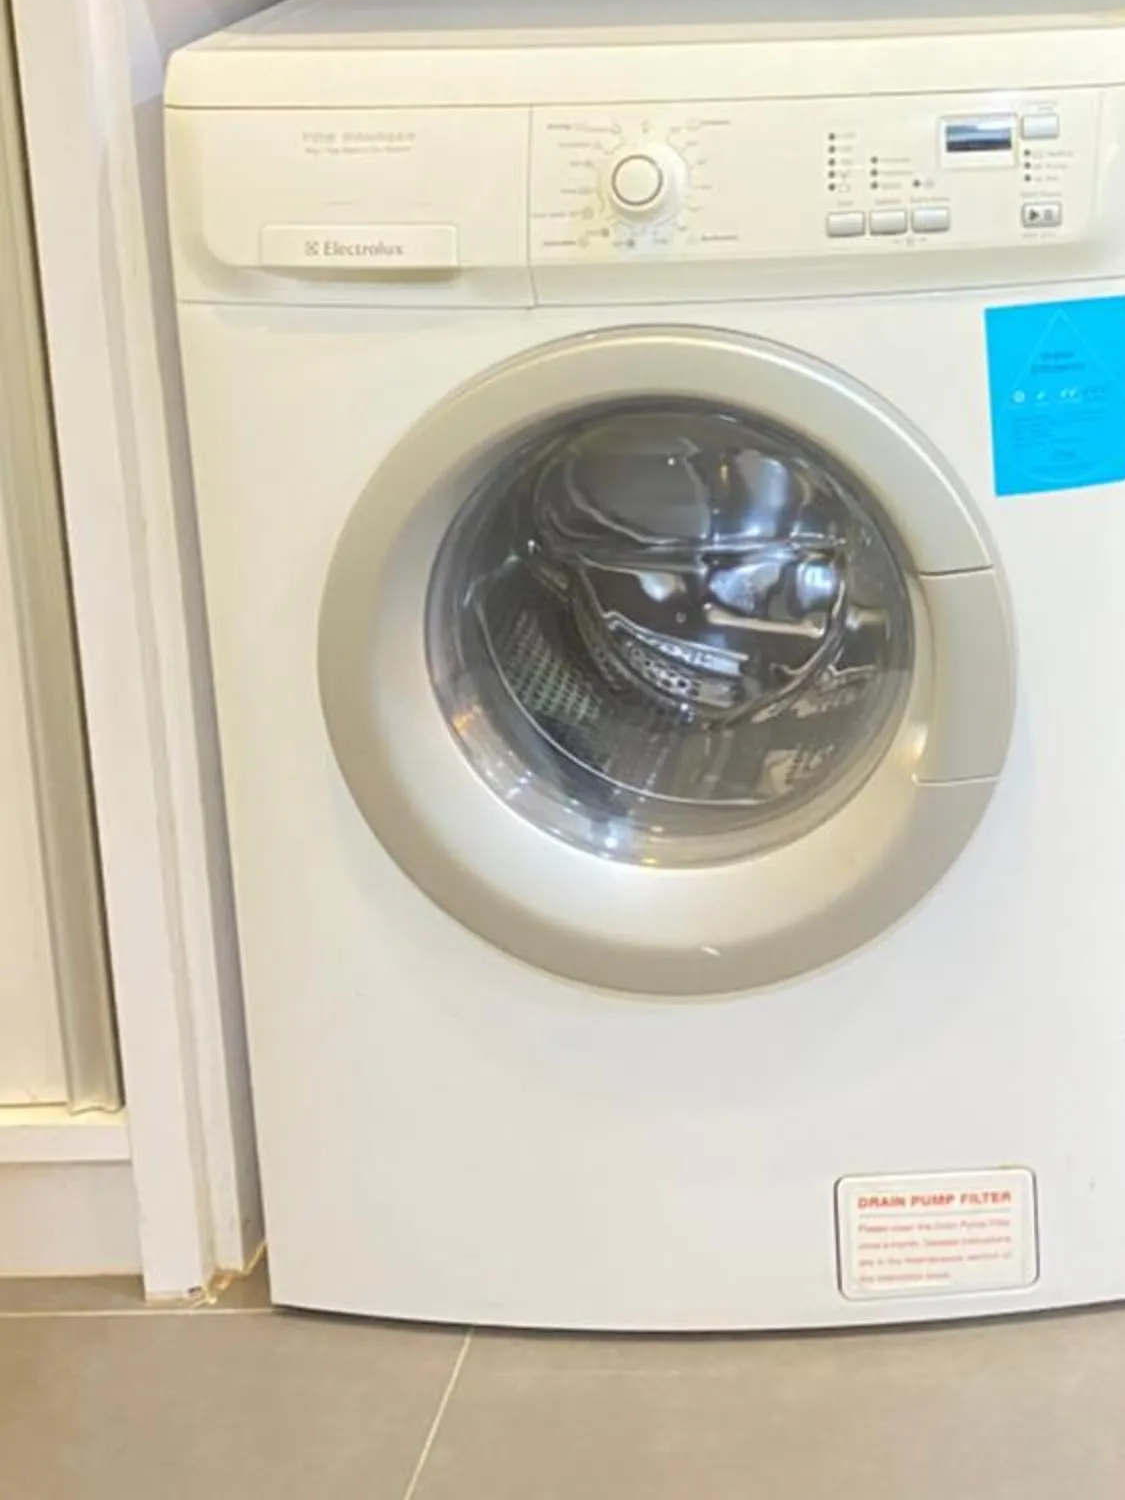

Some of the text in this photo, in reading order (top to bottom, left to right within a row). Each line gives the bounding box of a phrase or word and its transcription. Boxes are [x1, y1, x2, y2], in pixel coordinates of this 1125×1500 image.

[323, 239, 404, 256] Electrolux
[857, 1190, 1012, 1209] DRAIN PUMP FILTER
